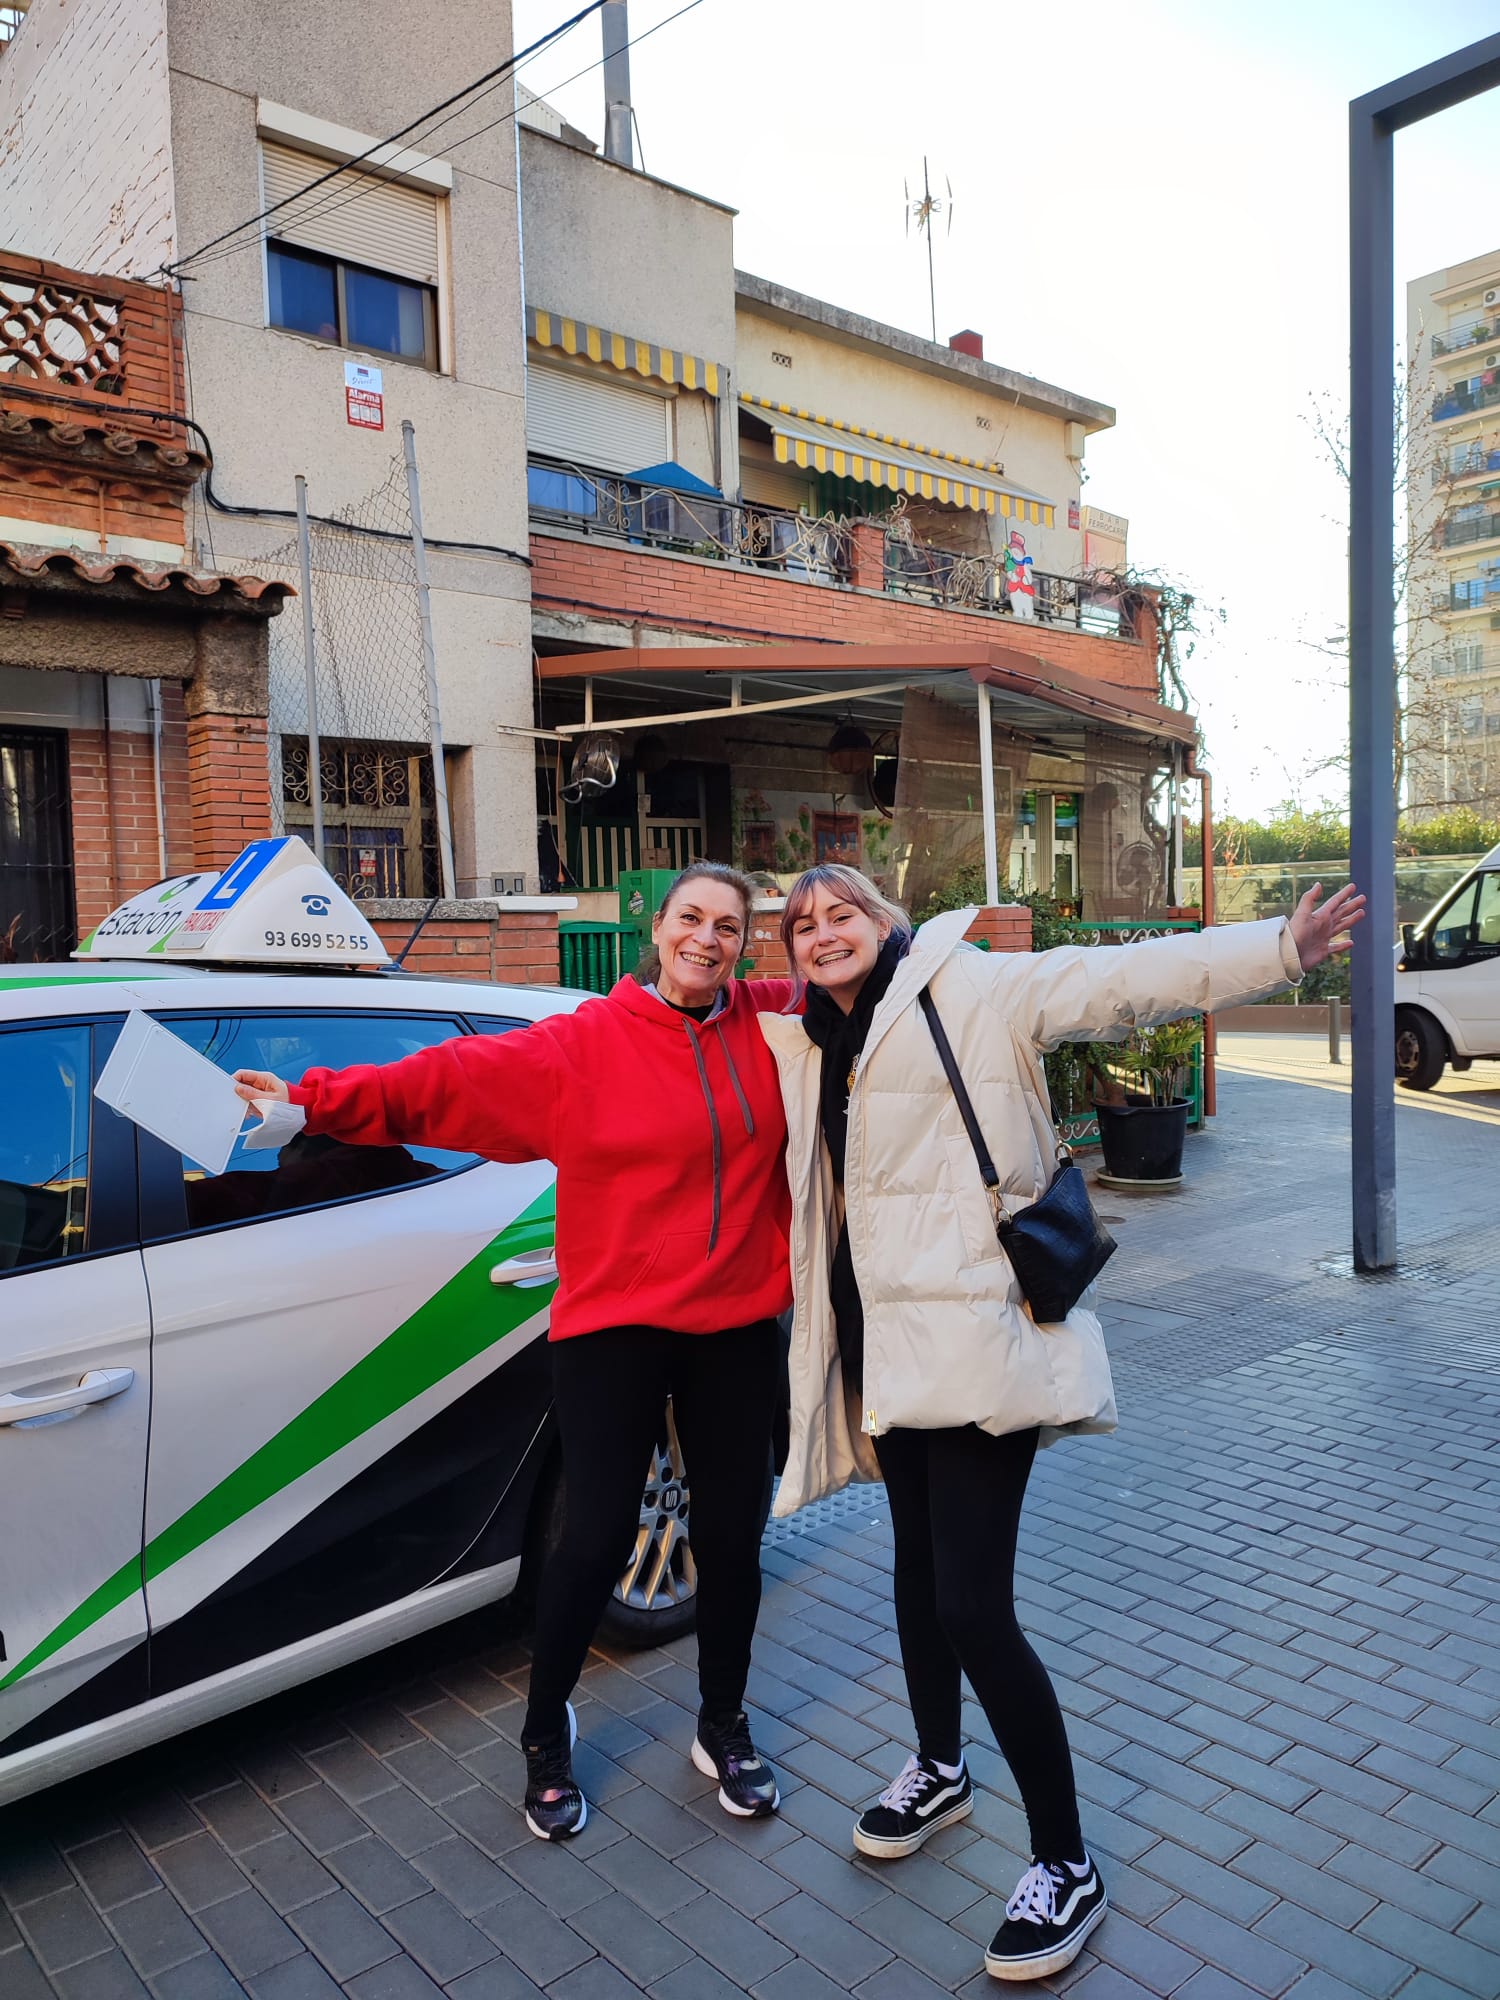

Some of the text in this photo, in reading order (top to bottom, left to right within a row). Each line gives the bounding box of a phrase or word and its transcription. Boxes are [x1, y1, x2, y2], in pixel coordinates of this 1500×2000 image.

[349, 389, 380, 403] Alarma
[212, 851, 259, 899] L
[97, 902, 183, 936] Estación
[265, 930, 368, 950] 93 699 52 55
